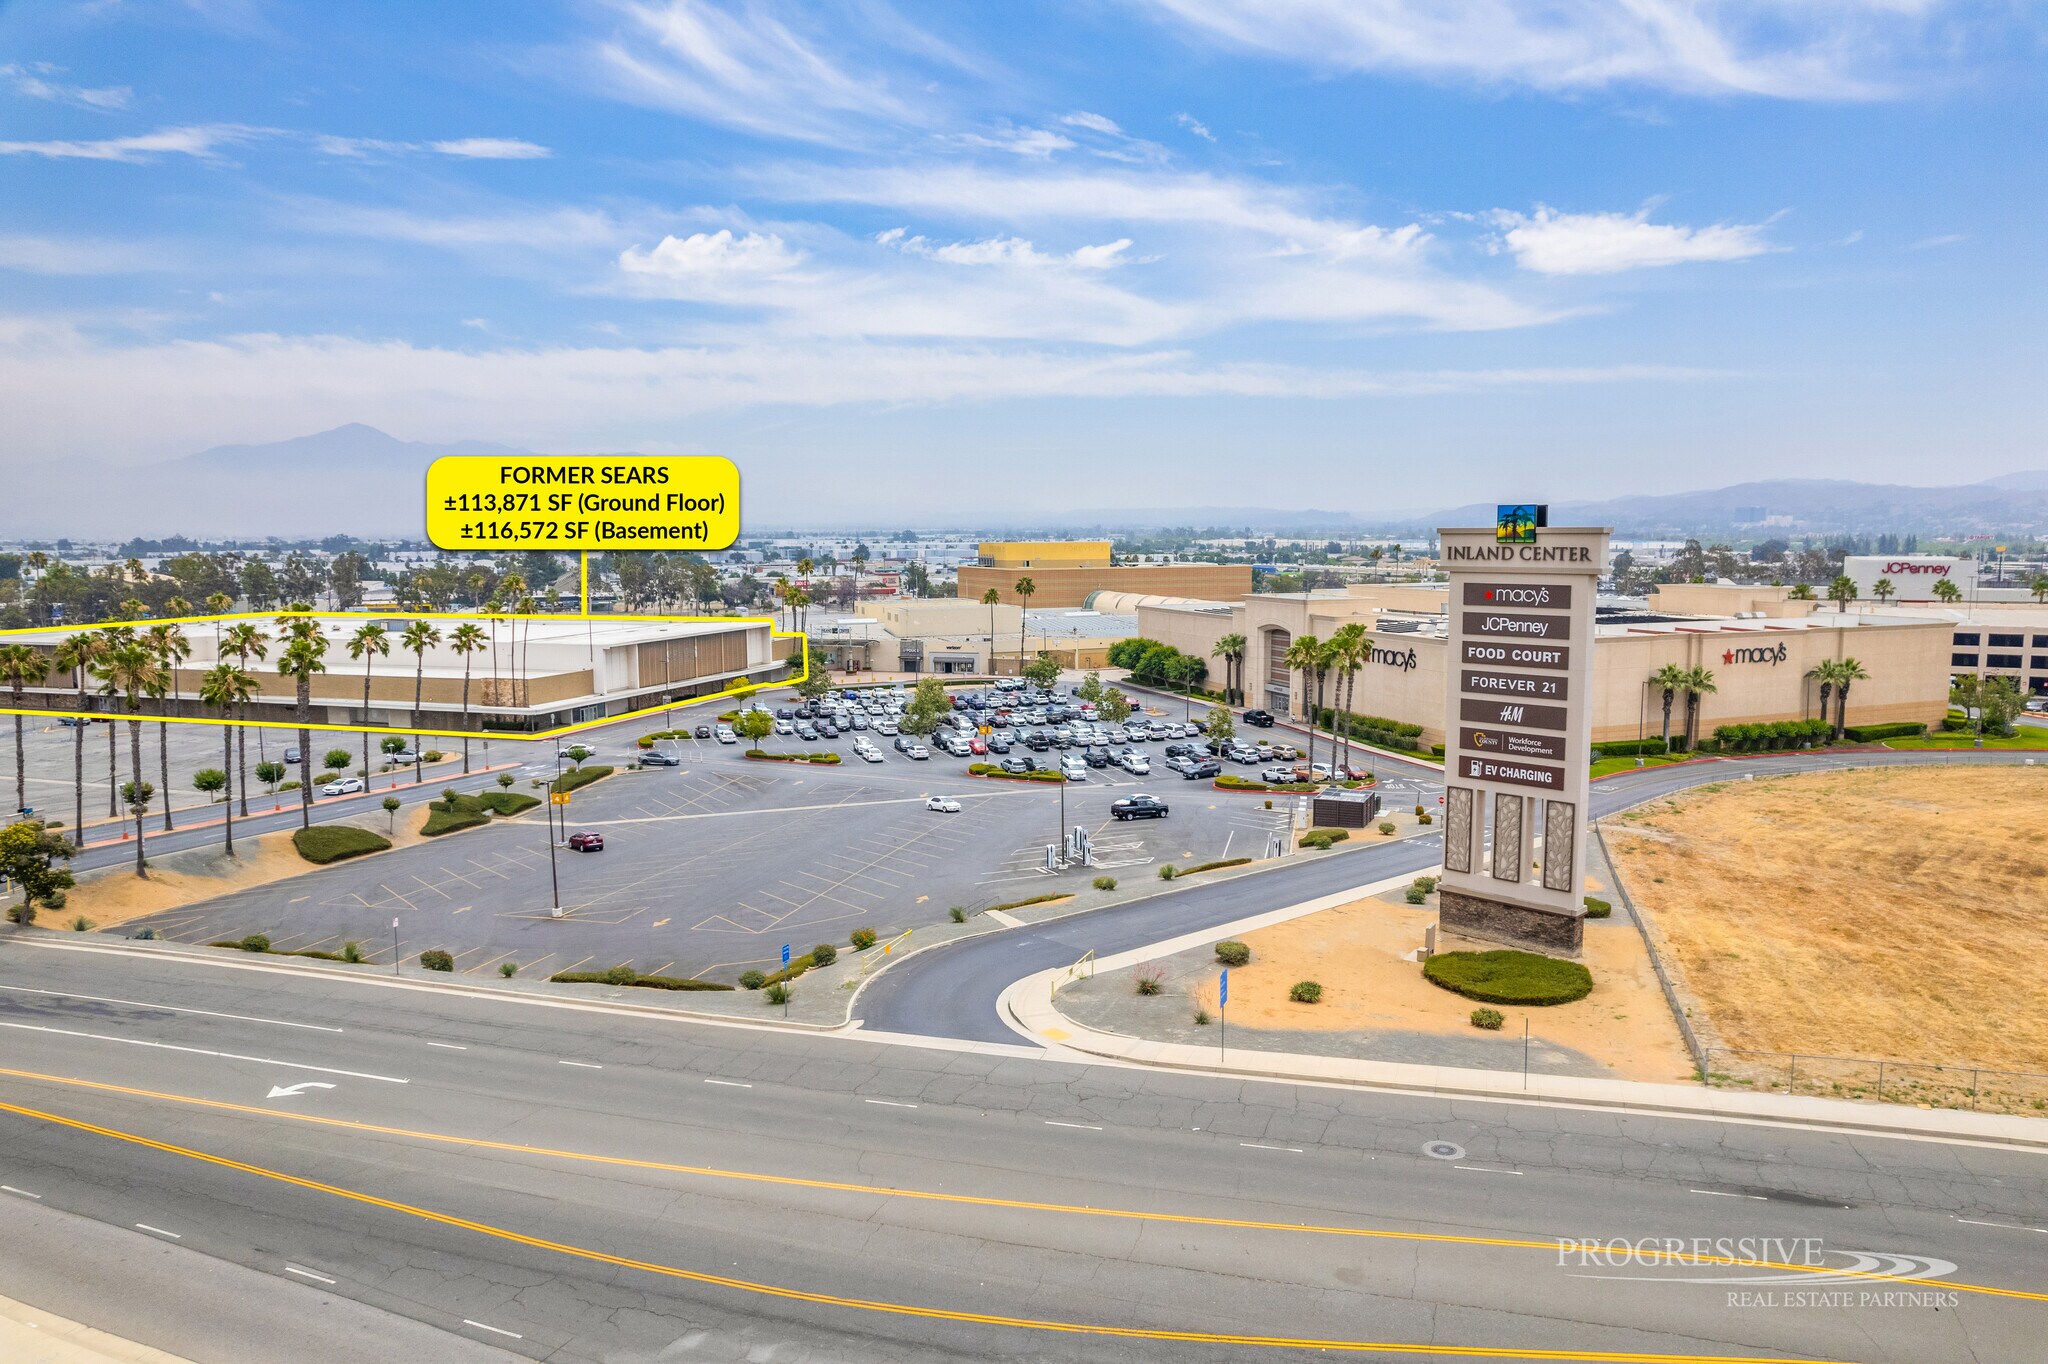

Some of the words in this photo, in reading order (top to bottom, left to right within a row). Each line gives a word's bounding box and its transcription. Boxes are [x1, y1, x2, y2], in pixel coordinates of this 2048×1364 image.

[1447, 546, 1514, 561] INLAND
[1519, 546, 1592, 562] CENTER
[1881, 562, 1951, 577] JCPenney
[1495, 586, 1550, 606] macy's
[1481, 617, 1549, 636] JCPenney
[1371, 647, 1417, 672] macy's
[1468, 647, 1506, 660] FOOD
[1511, 649, 1561, 663] COURT
[1735, 641, 1787, 666] macy's
[1471, 676, 1536, 692] FOREVER
[1542, 682, 1556, 694] 21
[1499, 705, 1524, 723] H&M
[1508, 736, 1542, 746] Workforce
[1508, 743, 1553, 755] Development
[1485, 764, 1498, 776] EV
[1499, 766, 1552, 783] CHARGING
